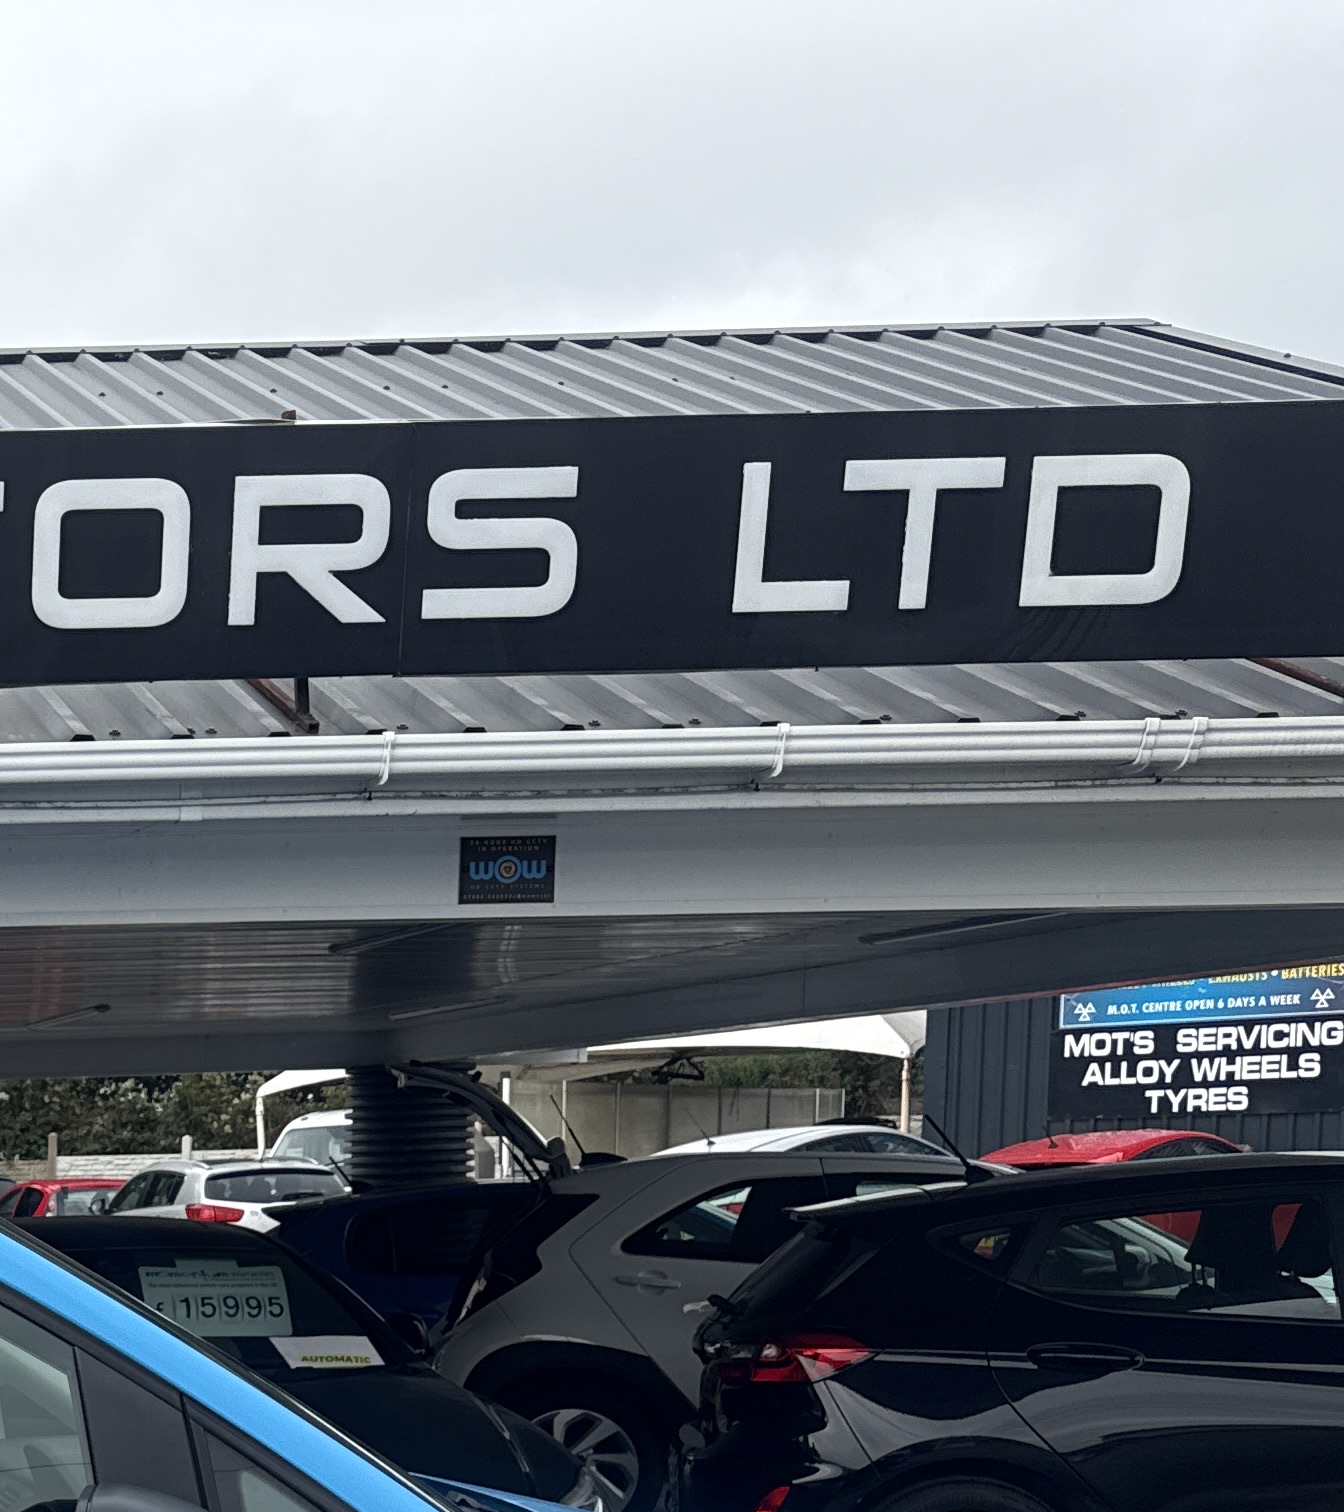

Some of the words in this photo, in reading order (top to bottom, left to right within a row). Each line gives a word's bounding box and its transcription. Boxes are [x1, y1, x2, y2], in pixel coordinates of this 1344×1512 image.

[732, 453, 1192, 614] LTD
[1106, 1003, 1139, 1015] M.O.T.
[1142, 1001, 1182, 1013] CENTRE
[1185, 998, 1214, 1011] OPEN
[1217, 998, 1225, 1009] 6
[1227, 996, 1255, 1008] DAYS
[1258, 996, 1266, 1007] A
[1270, 994, 1301, 1006] WEEK
[1063, 1030, 1155, 1057] MOT'S
[1176, 1020, 1344, 1053] SERVICING
[1081, 1058, 1181, 1086] ALLOY
[1191, 1052, 1321, 1082] WHEELS
[1145, 1086, 1249, 1113] TYRES
[301, 1354, 371, 1364] AUTOMATIC
